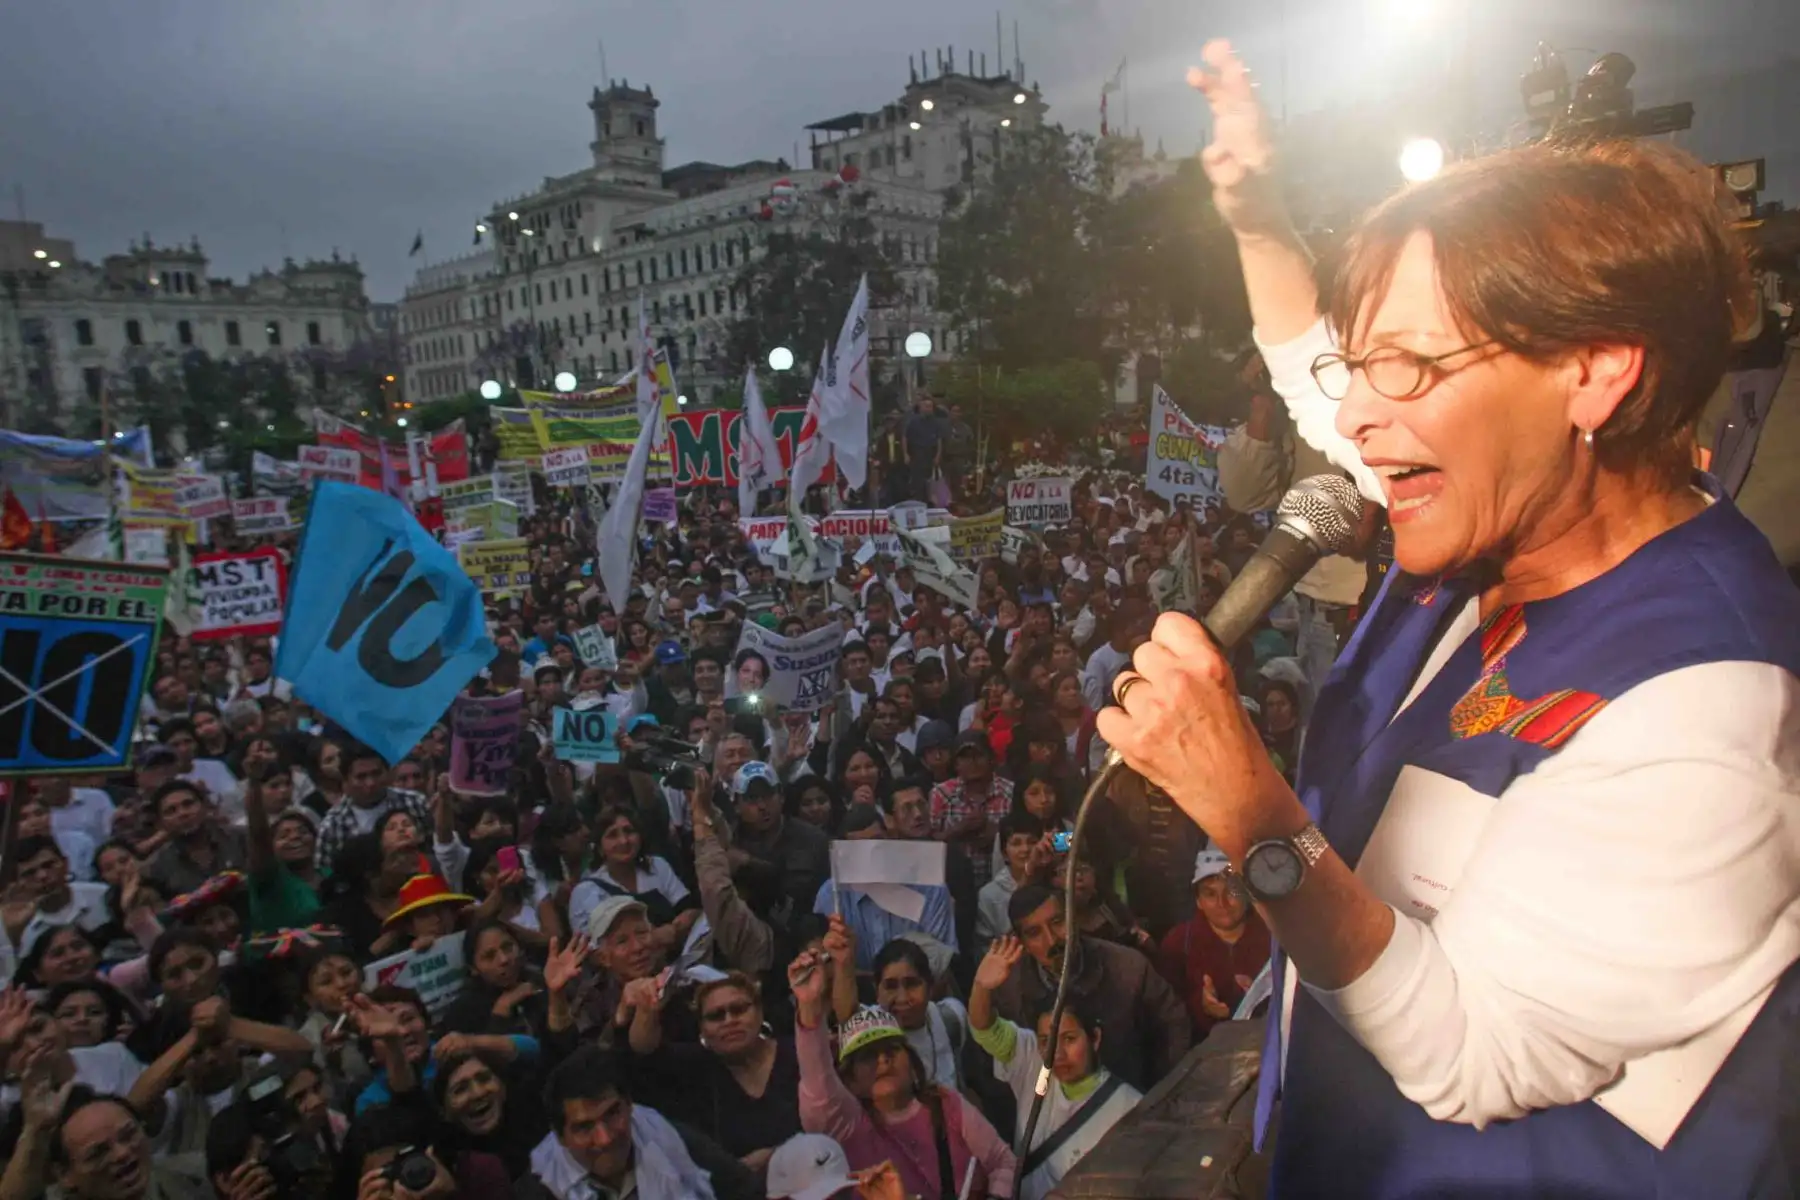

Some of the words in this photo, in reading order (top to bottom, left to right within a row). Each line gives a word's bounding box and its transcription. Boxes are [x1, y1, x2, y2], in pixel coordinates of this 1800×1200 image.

[1012, 482, 1035, 499] NO
[1008, 503, 1070, 521] REVOCATORIA
[38, 593, 108, 616] POR
[562, 711, 606, 743] NO
